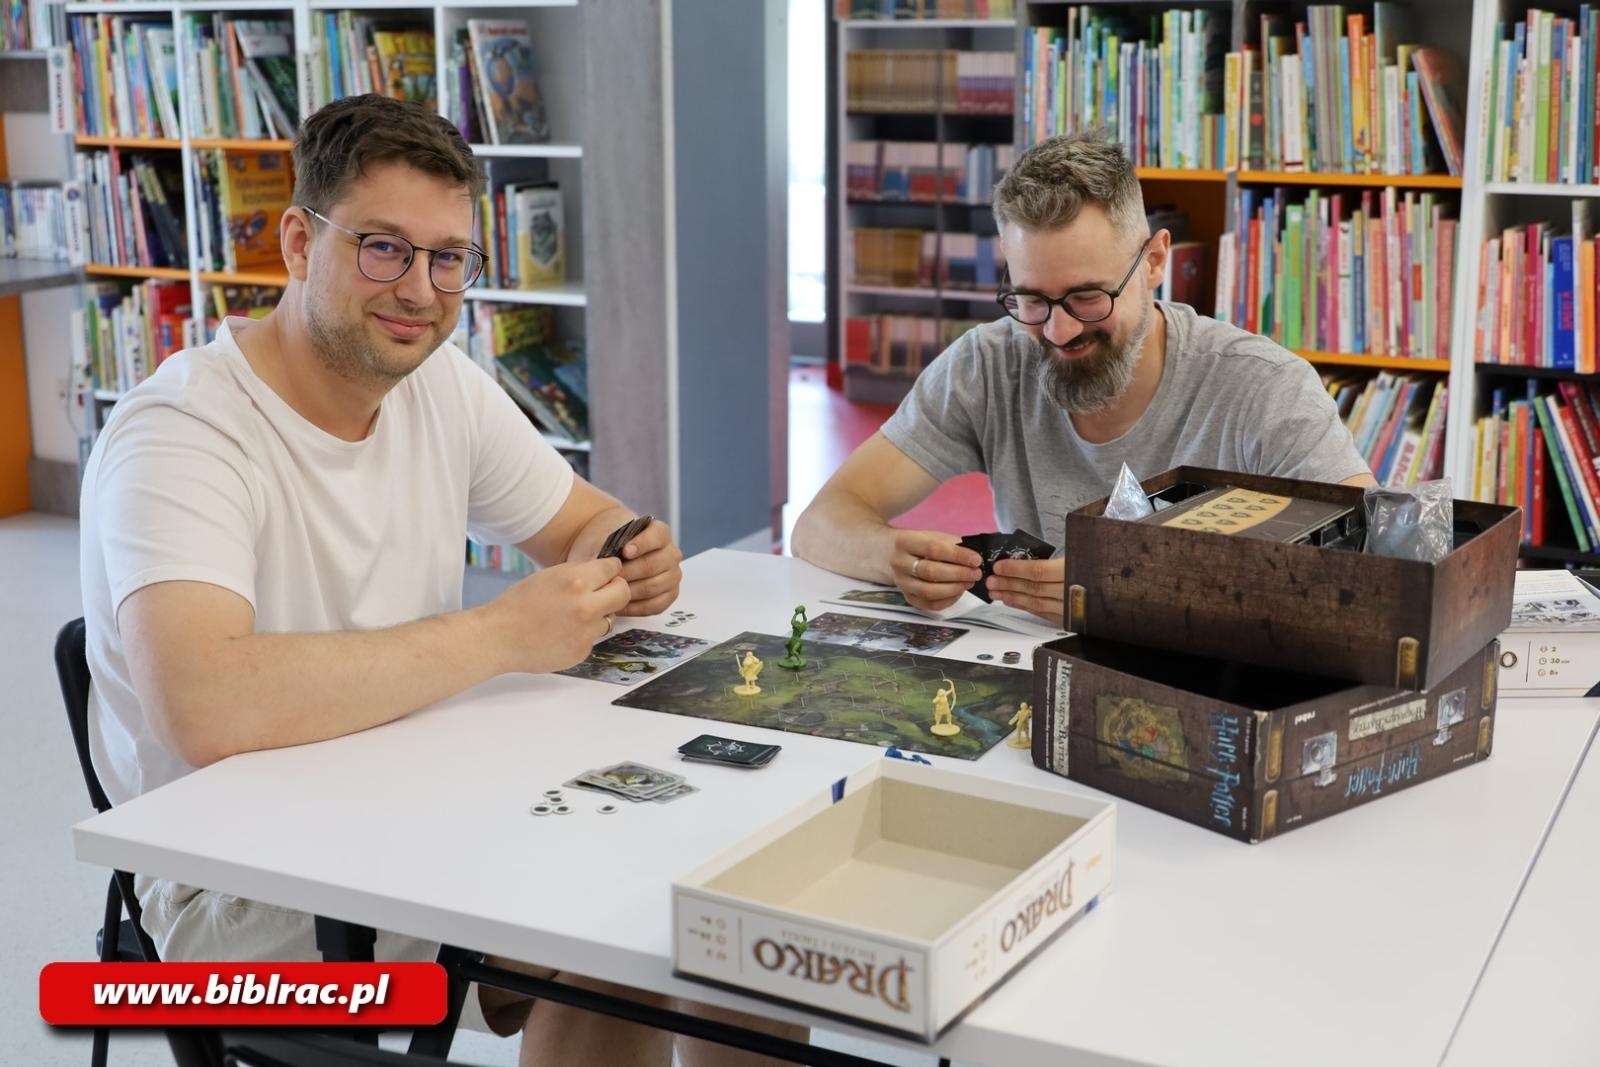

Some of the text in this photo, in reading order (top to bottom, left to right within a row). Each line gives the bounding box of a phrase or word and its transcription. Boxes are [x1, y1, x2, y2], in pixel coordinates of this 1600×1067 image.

[1294, 710, 1317, 725] rebel
[1000, 860, 1076, 954] DRAKO
[753, 938, 914, 1015] DRAKO
